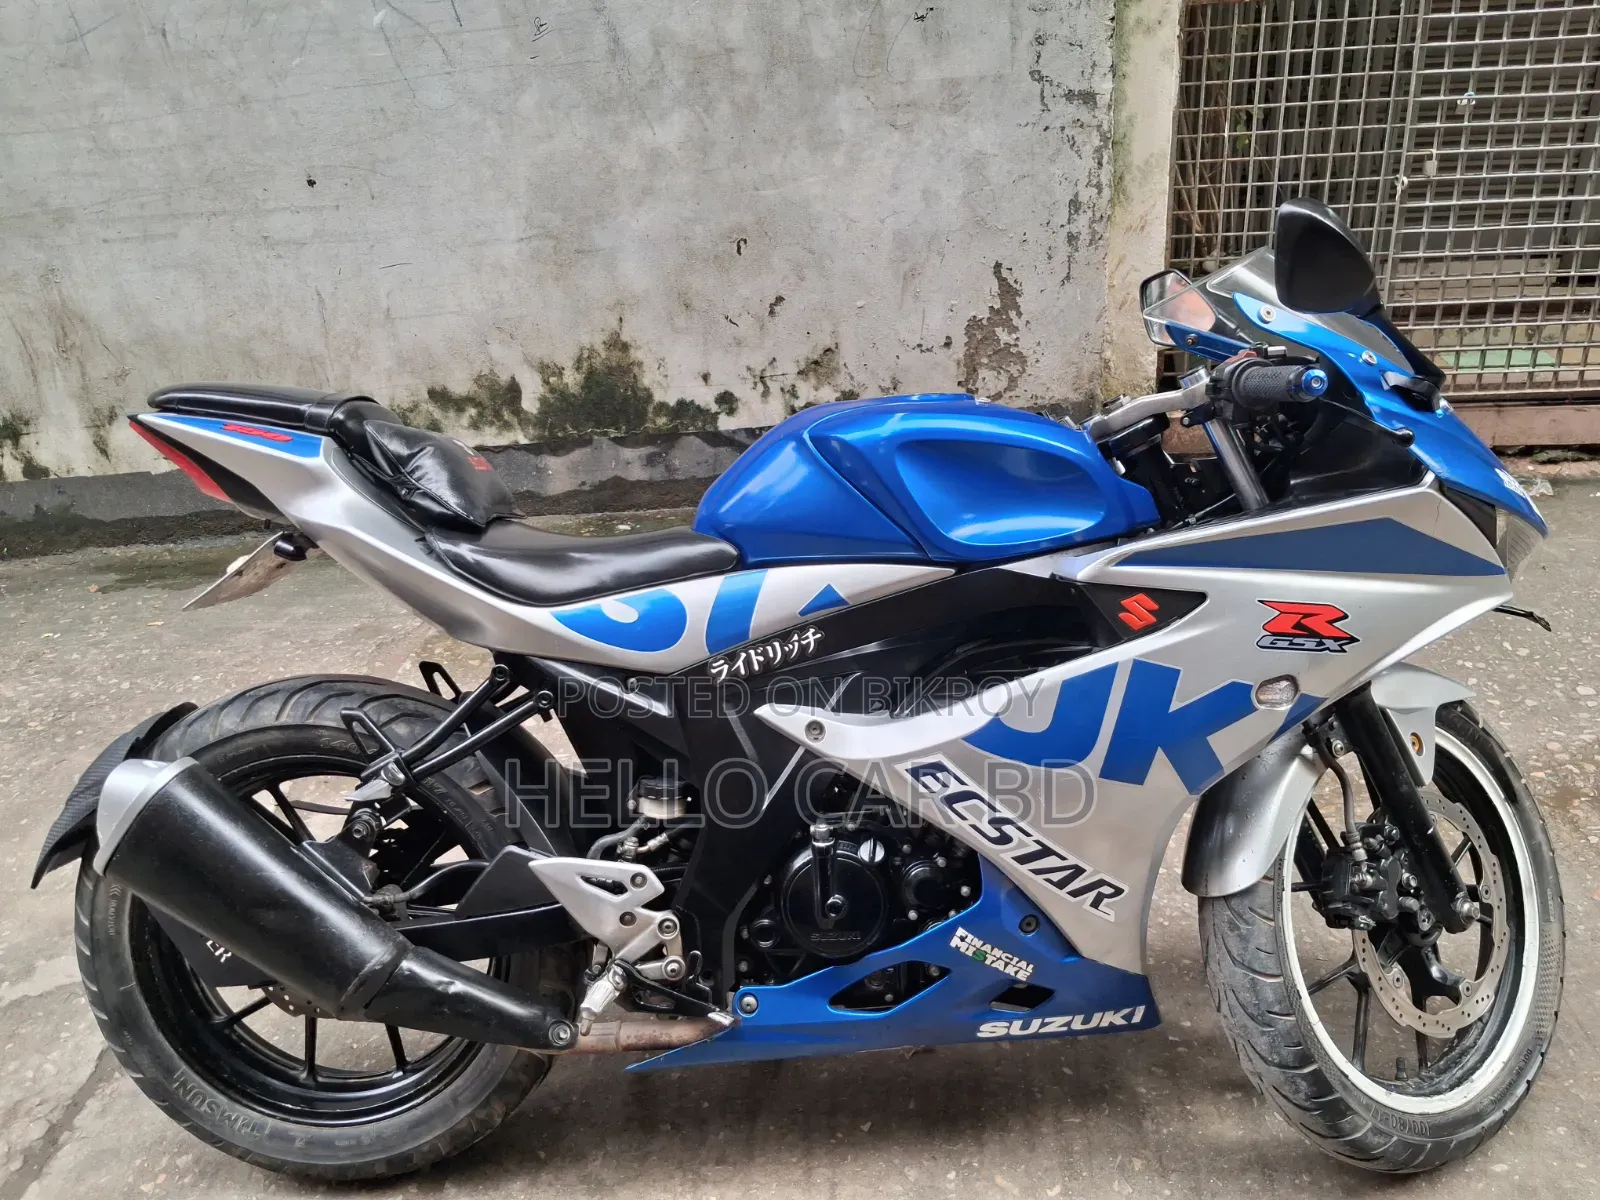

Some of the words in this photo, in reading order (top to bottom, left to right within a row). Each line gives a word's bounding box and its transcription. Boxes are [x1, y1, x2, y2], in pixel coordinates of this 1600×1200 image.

[710, 627, 823, 683] ライドリッチ
[1257, 635, 1348, 653] GSX
[897, 756, 1127, 919] ECSTAR
[949, 935, 1031, 981] MISTAKE
[955, 926, 1034, 973] FINANCIAL
[976, 1005, 1146, 1038] SUZUKI
